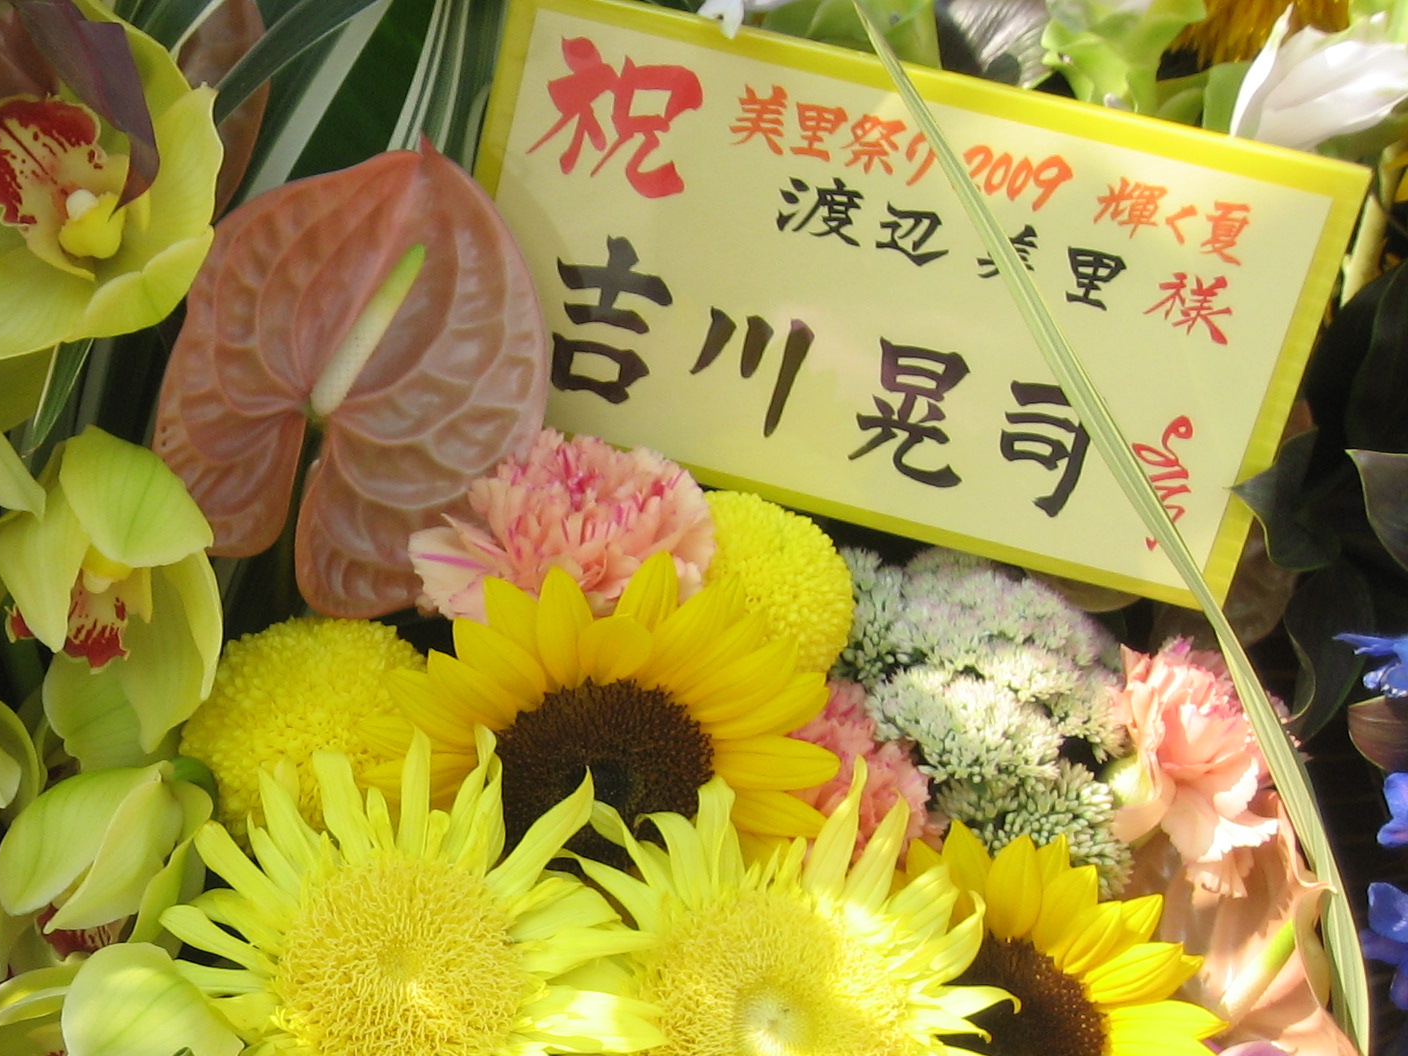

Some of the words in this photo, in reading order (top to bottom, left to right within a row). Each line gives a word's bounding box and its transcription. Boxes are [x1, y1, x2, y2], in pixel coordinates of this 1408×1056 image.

[525, 35, 704, 199] 祝
[728, 83, 939, 188] 美里祭り
[952, 143, 1075, 213] 2009
[1093, 175, 1252, 267] 輝く夏
[775, 175, 950, 268] 渡辺
[1142, 271, 1234, 346] 様
[550, 234, 816, 438] 吉川
[847, 335, 1092, 518] 晃司
